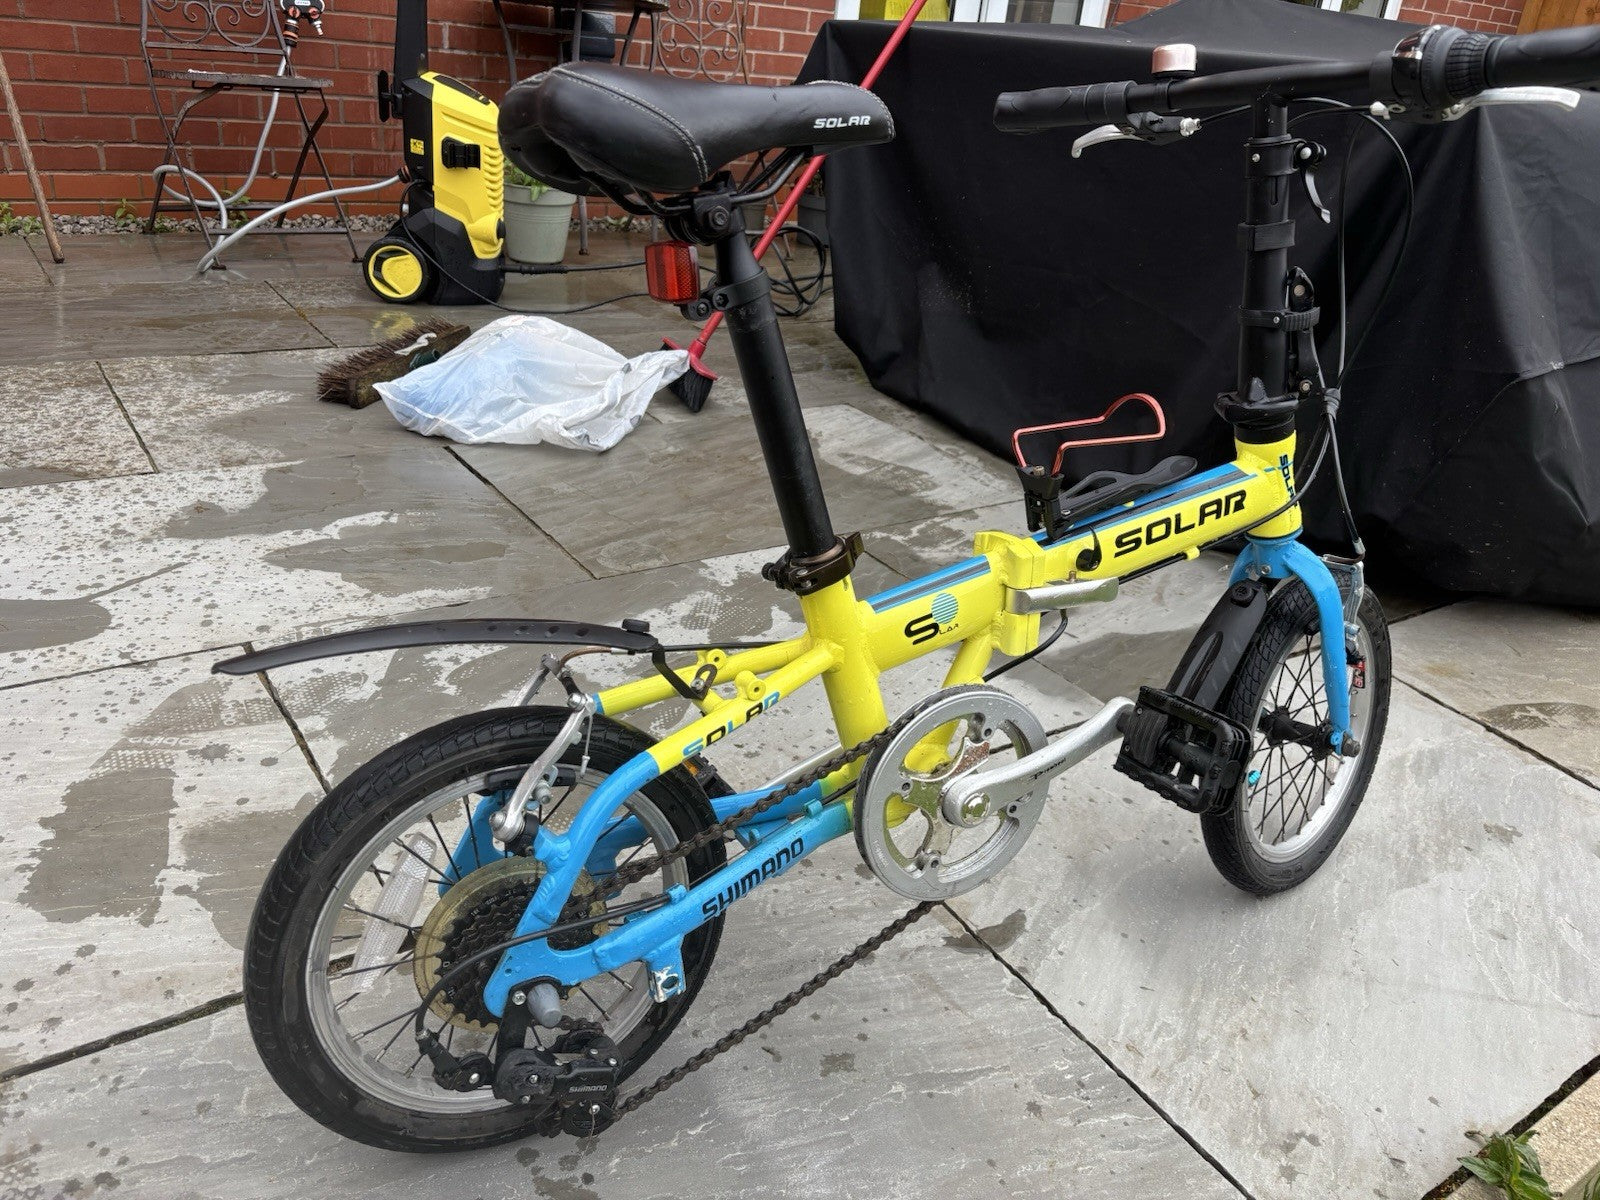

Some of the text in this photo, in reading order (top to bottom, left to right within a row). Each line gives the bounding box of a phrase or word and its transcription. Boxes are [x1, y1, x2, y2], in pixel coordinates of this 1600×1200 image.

[813, 115, 871, 129] SOLAR
[1114, 489, 1247, 558] SOLAR
[702, 837, 804, 921] SHIMANO
[569, 1084, 608, 1093] SHIMANO
